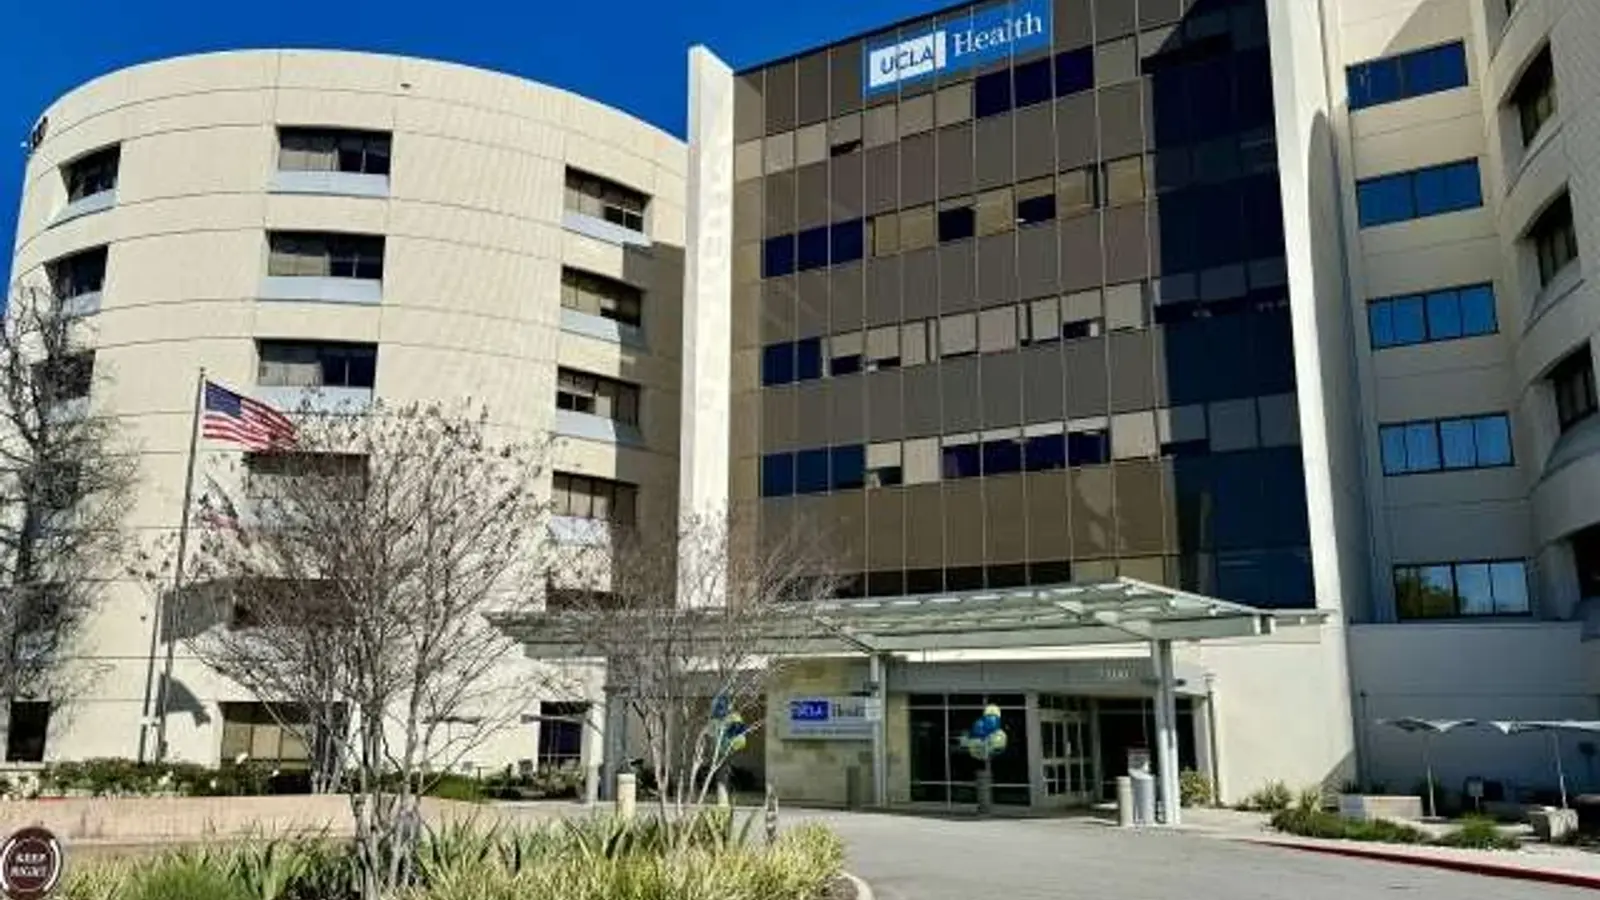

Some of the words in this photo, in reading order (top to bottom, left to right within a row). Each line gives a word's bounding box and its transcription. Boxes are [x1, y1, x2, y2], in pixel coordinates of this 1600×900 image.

[880, 45, 935, 75] UCLA
[952, 11, 1042, 57] Health
[16, 853, 47, 863] KEEP
[11, 866, 47, 877] RIGHT
